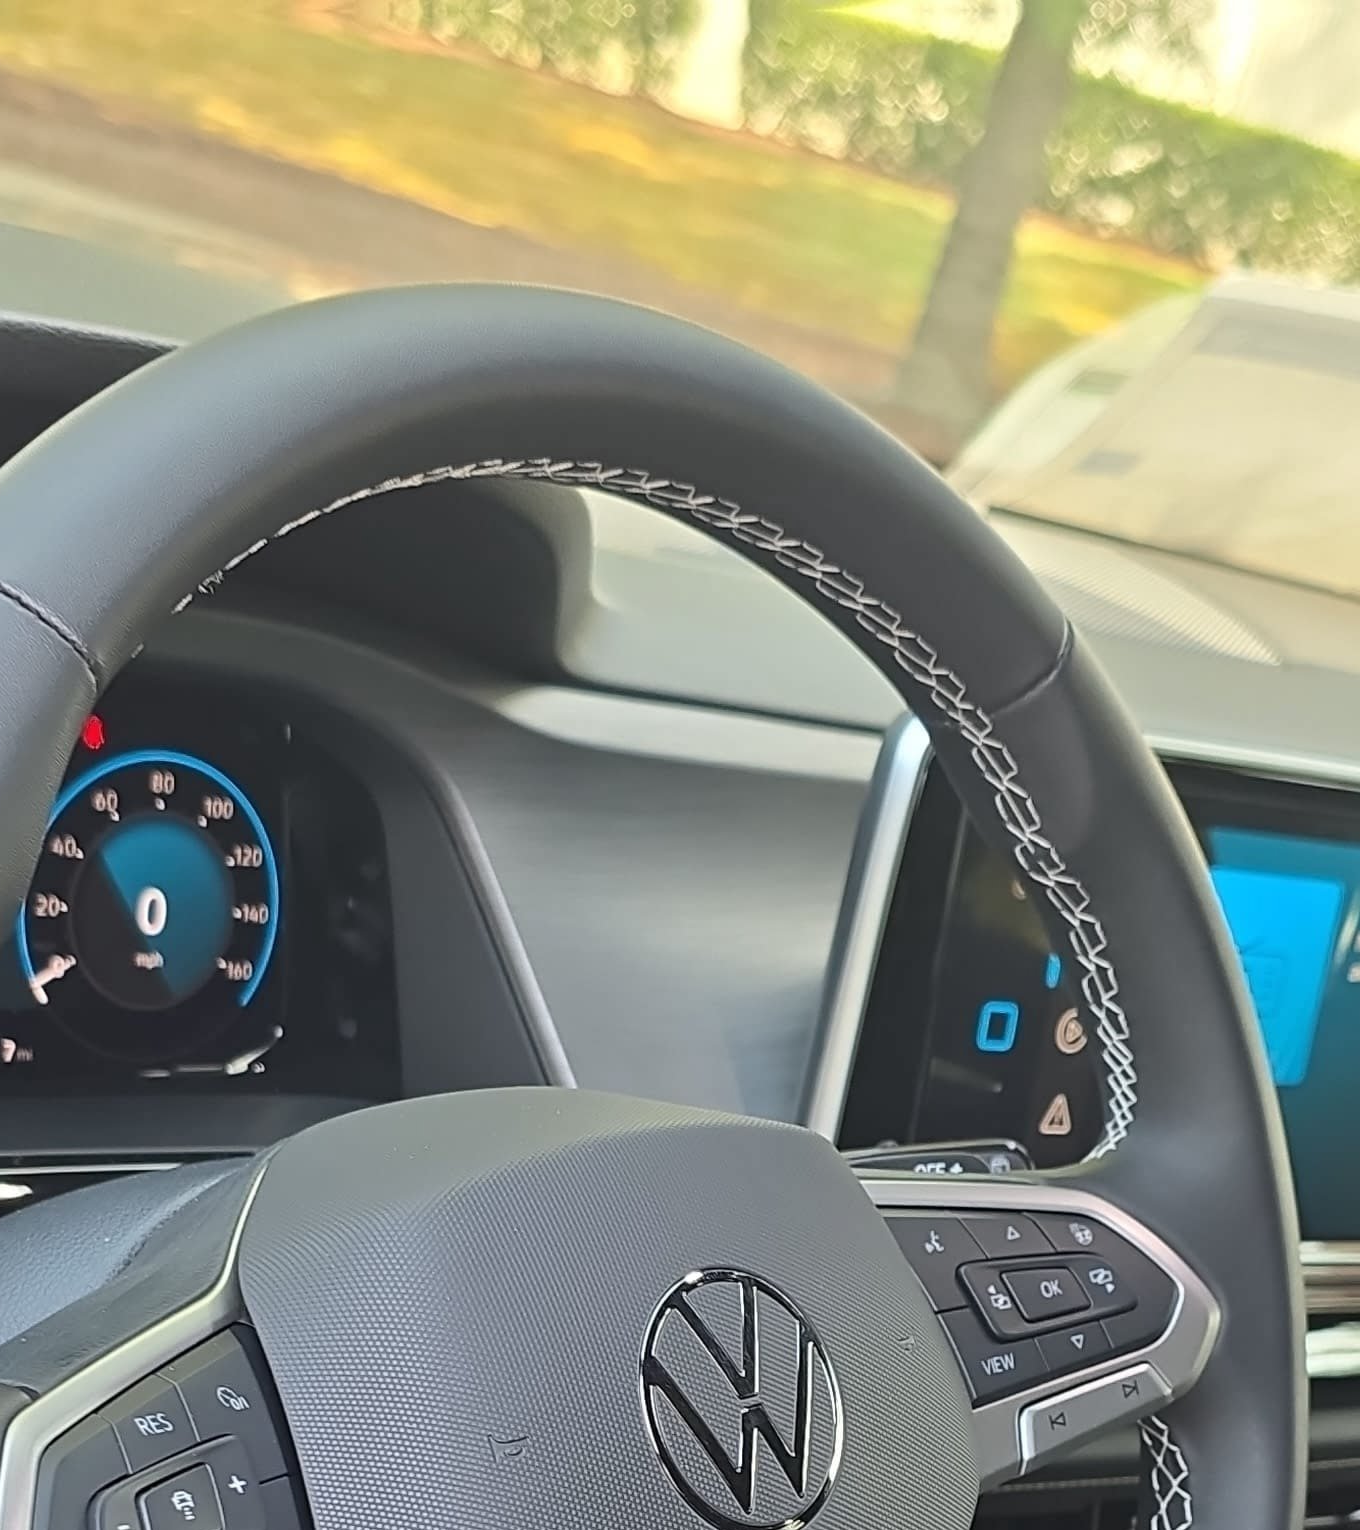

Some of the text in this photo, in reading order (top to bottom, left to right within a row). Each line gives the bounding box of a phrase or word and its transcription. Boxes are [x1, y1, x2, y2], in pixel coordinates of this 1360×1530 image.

[150, 769, 176, 795] 80
[91, 788, 119, 812] 60
[203, 796, 235, 820] 100
[232, 844, 264, 868] 120
[34, 892, 61, 917] 20
[134, 886, 168, 937] 0
[240, 903, 269, 924] 140
[1039, 1279, 1064, 1299] OK
[980, 1352, 1017, 1376] VIEW
[133, 1411, 175, 1437] RES
